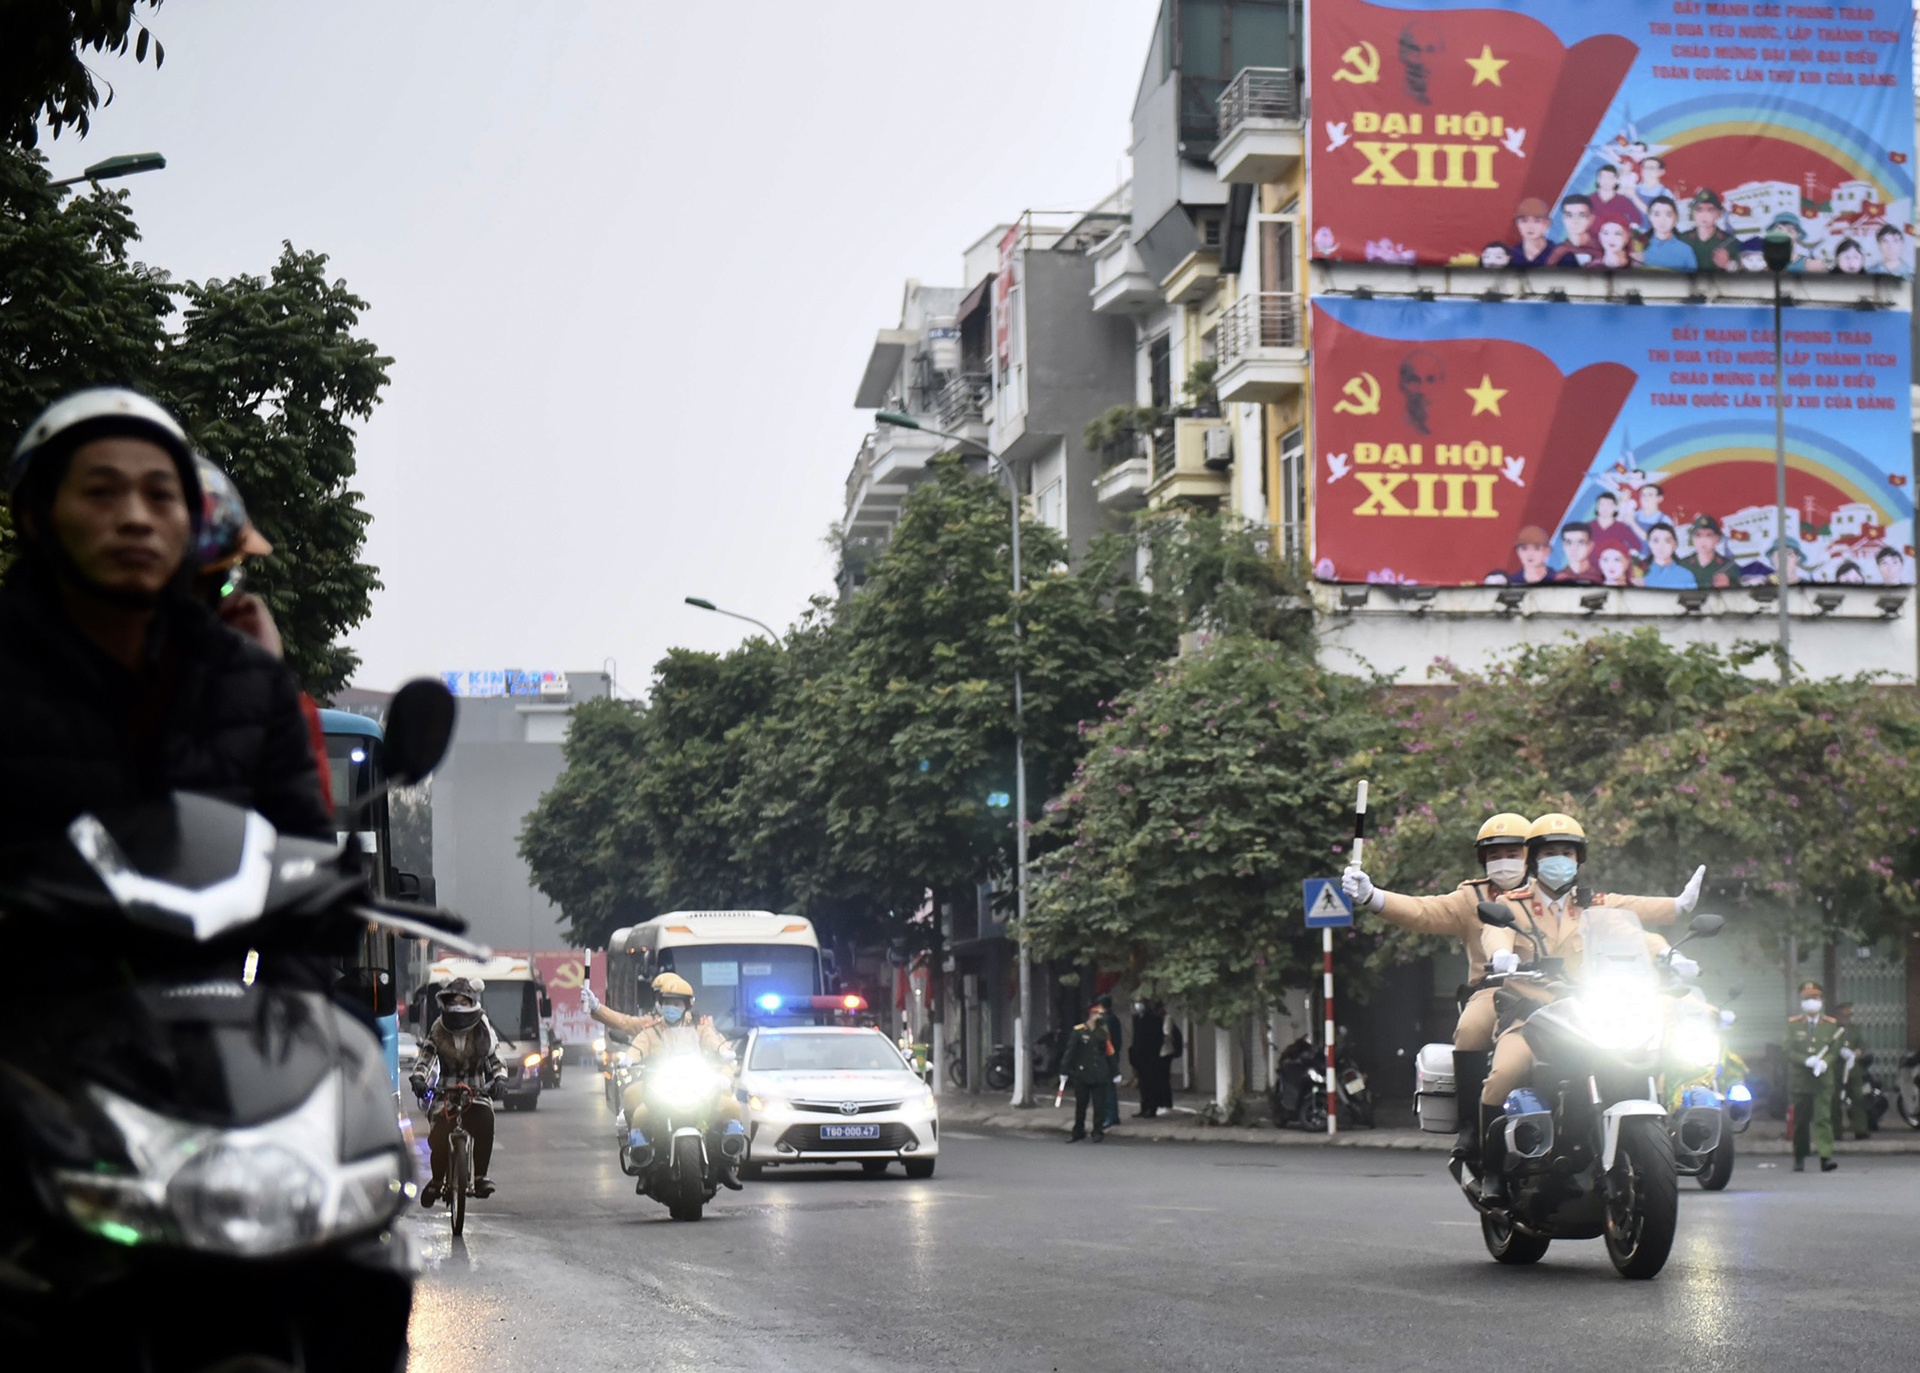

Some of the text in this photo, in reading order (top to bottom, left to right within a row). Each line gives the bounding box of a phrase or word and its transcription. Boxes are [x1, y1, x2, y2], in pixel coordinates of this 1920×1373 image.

[1353, 111, 1504, 141] ĐẠI HỘI
[1352, 141, 1500, 189] XIII
[1353, 440, 1503, 471] ĐẠI HỘI
[1352, 472, 1500, 518] XIII
[468, 670, 556, 684] KINTARO
